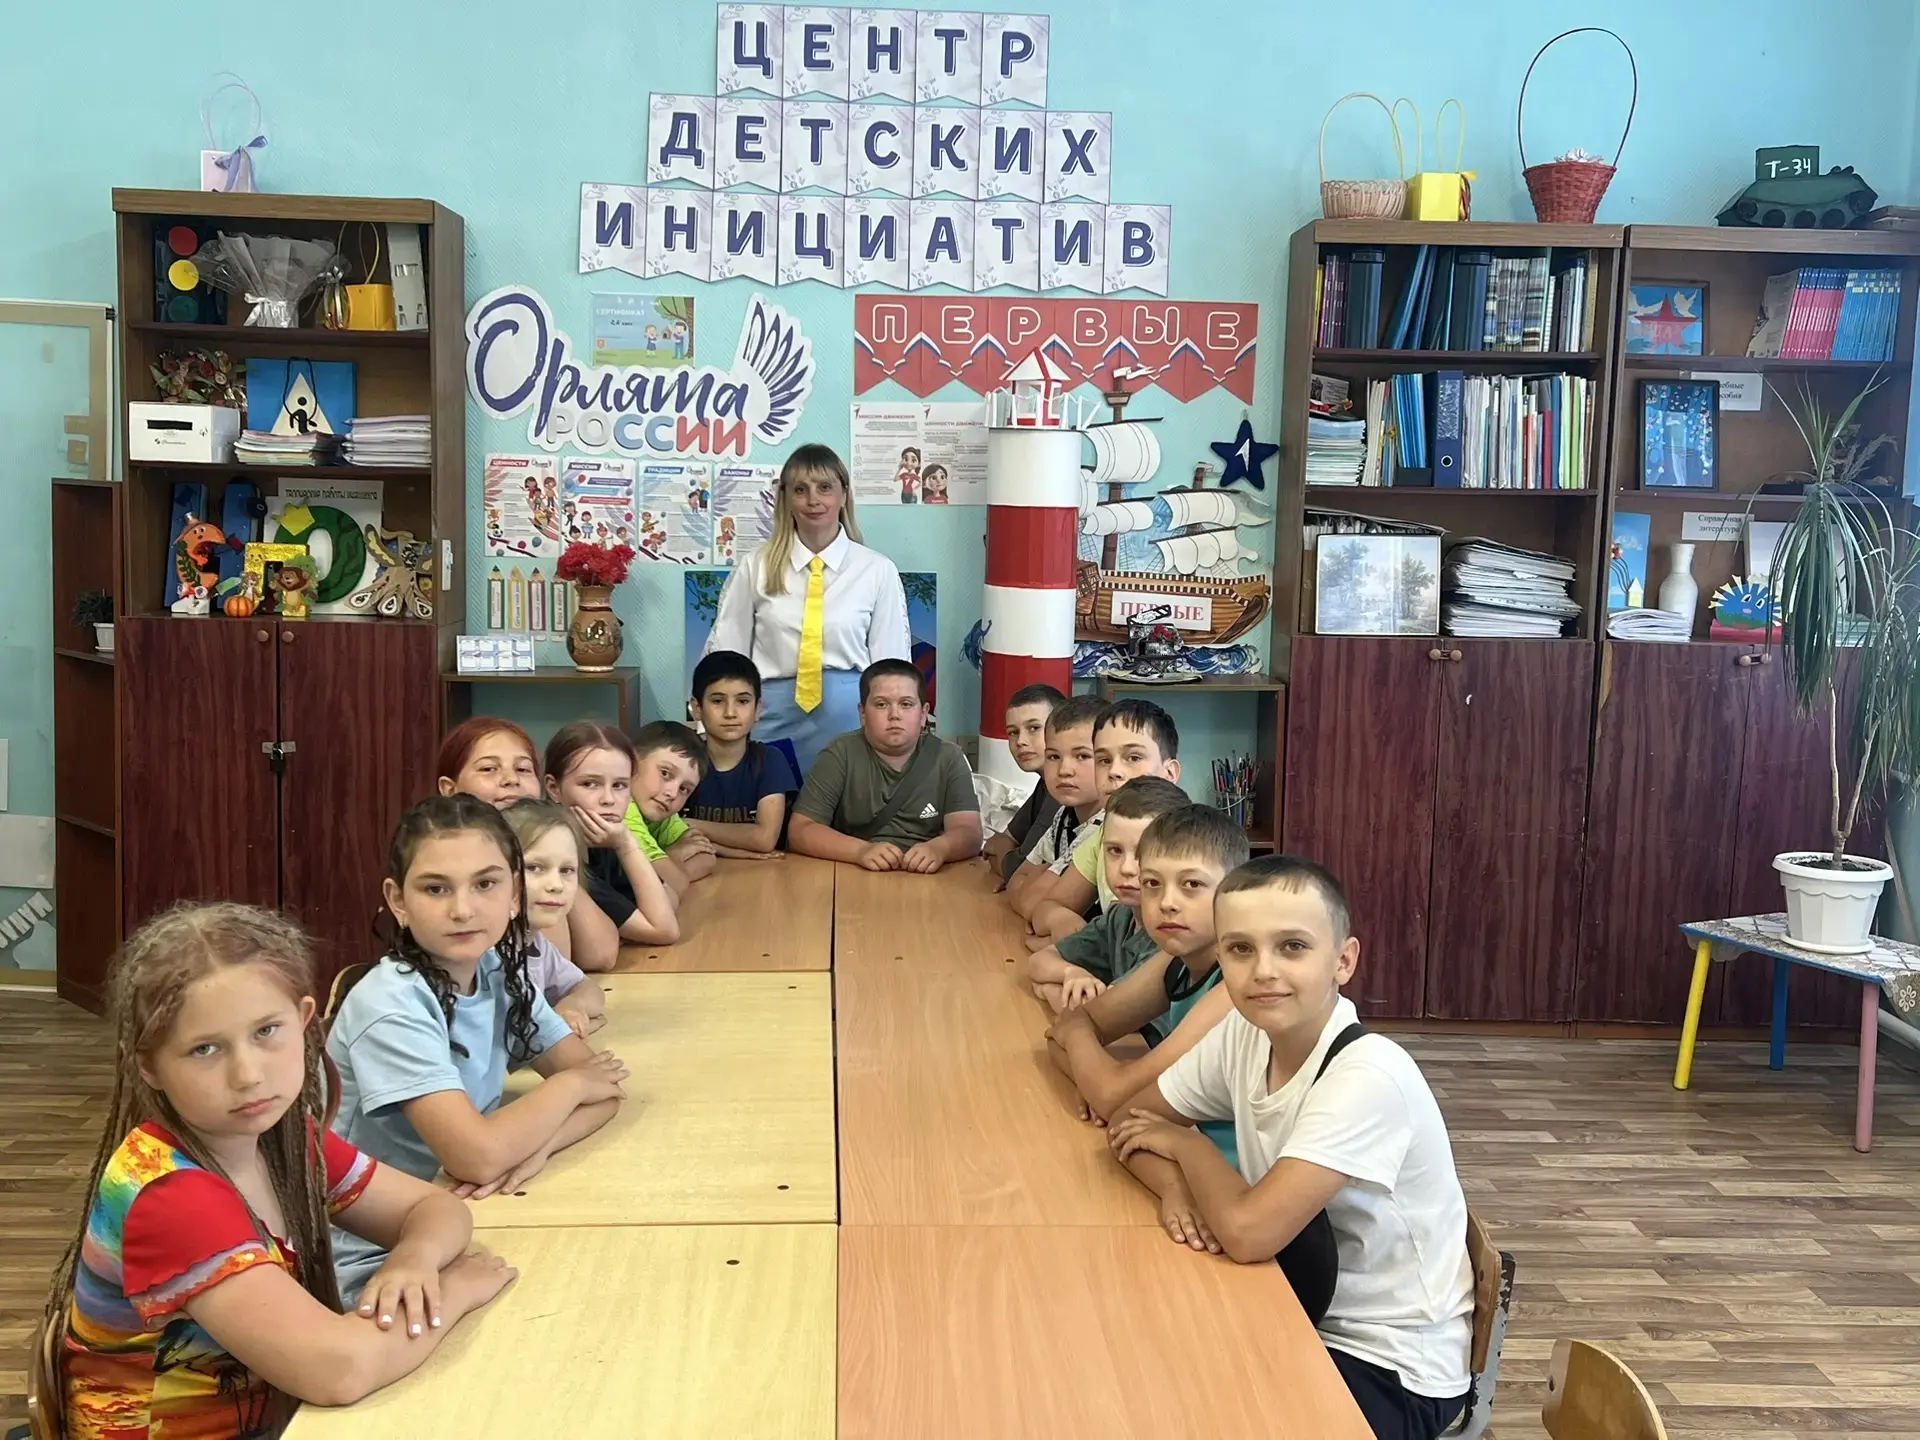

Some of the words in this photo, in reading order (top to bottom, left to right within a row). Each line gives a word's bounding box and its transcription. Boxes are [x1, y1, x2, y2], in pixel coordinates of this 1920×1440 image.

[733, 20, 1035, 79] ЦЕНТР
[659, 111, 1097, 175] ДЕТСКИХ
[1764, 157, 1812, 179] Т-34
[597, 200, 1155, 267] ИНИЦИАТИВ
[872, 303, 1241, 351] ПЕРВЫЕ
[474, 293, 749, 438] Орлята
[1720, 381, 1745, 389] ебные
[1720, 391, 1742, 399] особия
[545, 408, 747, 456] РОССИИ
[1120, 601, 1204, 621] ПЕЫЕ
